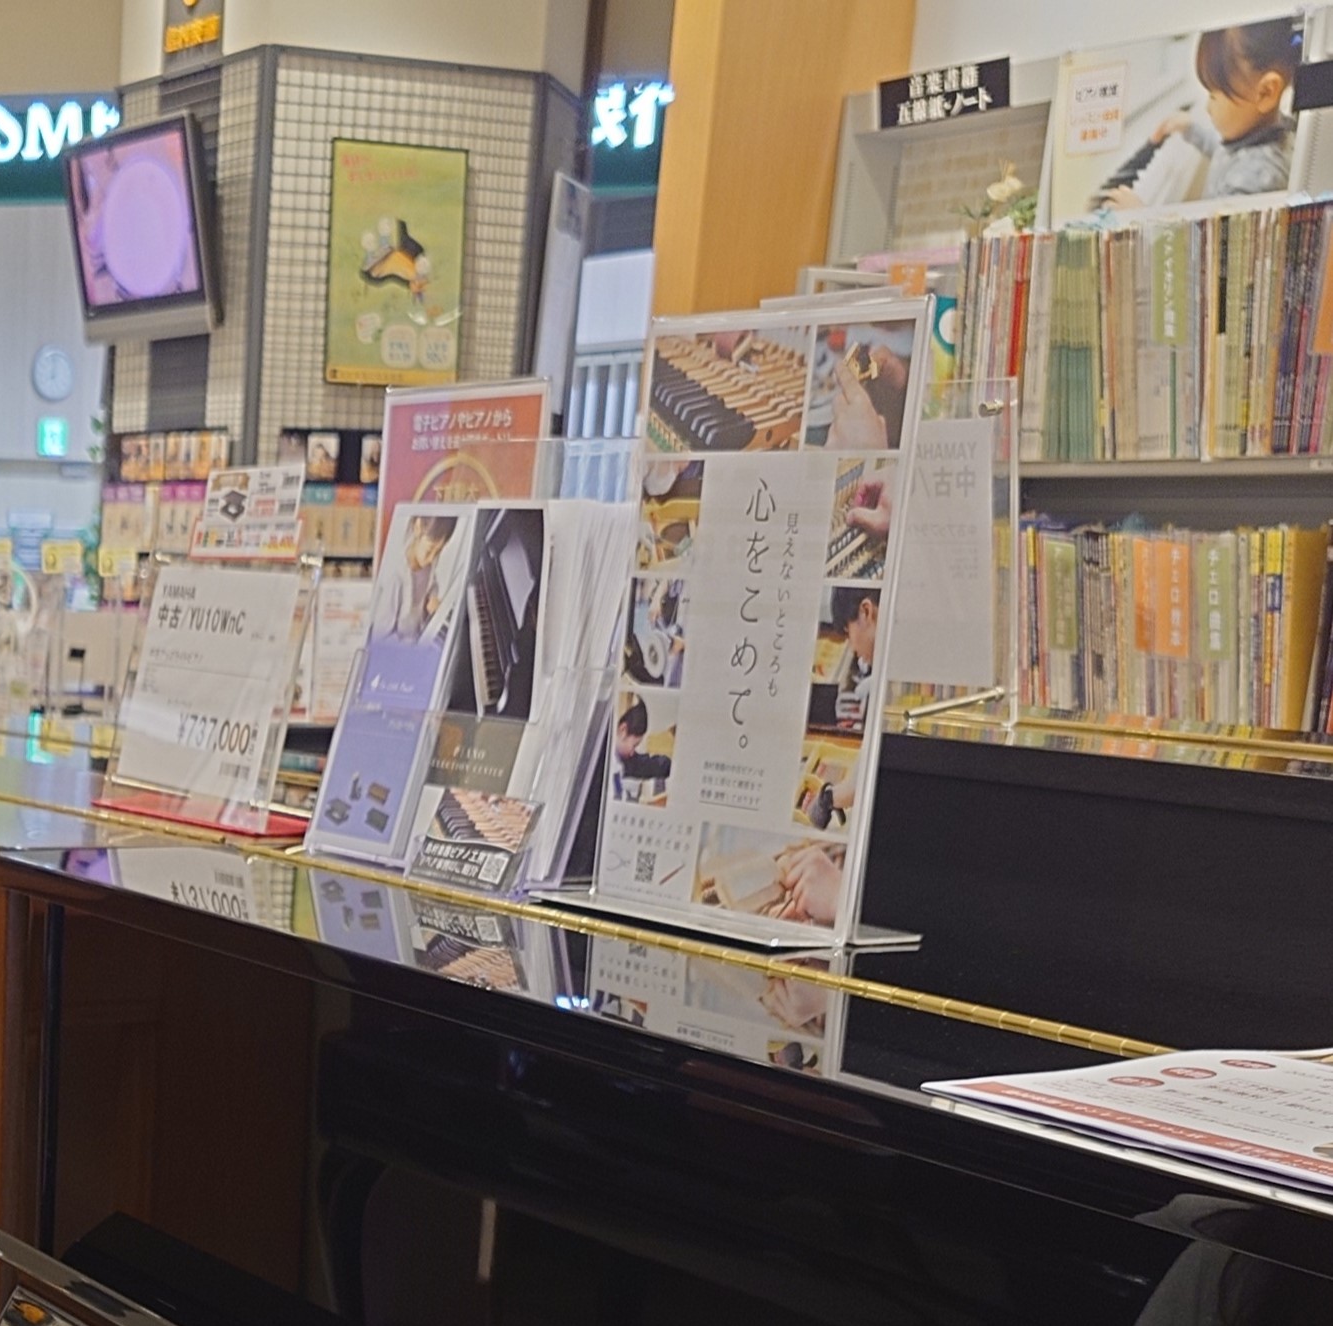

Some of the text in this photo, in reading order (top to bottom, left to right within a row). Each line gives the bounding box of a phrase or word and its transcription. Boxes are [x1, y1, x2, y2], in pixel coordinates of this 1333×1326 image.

[728, 477, 776, 750] 心をこめて。
[767, 512, 799, 698] 見えないところも
[178, 713, 252, 755] ¥737,000
